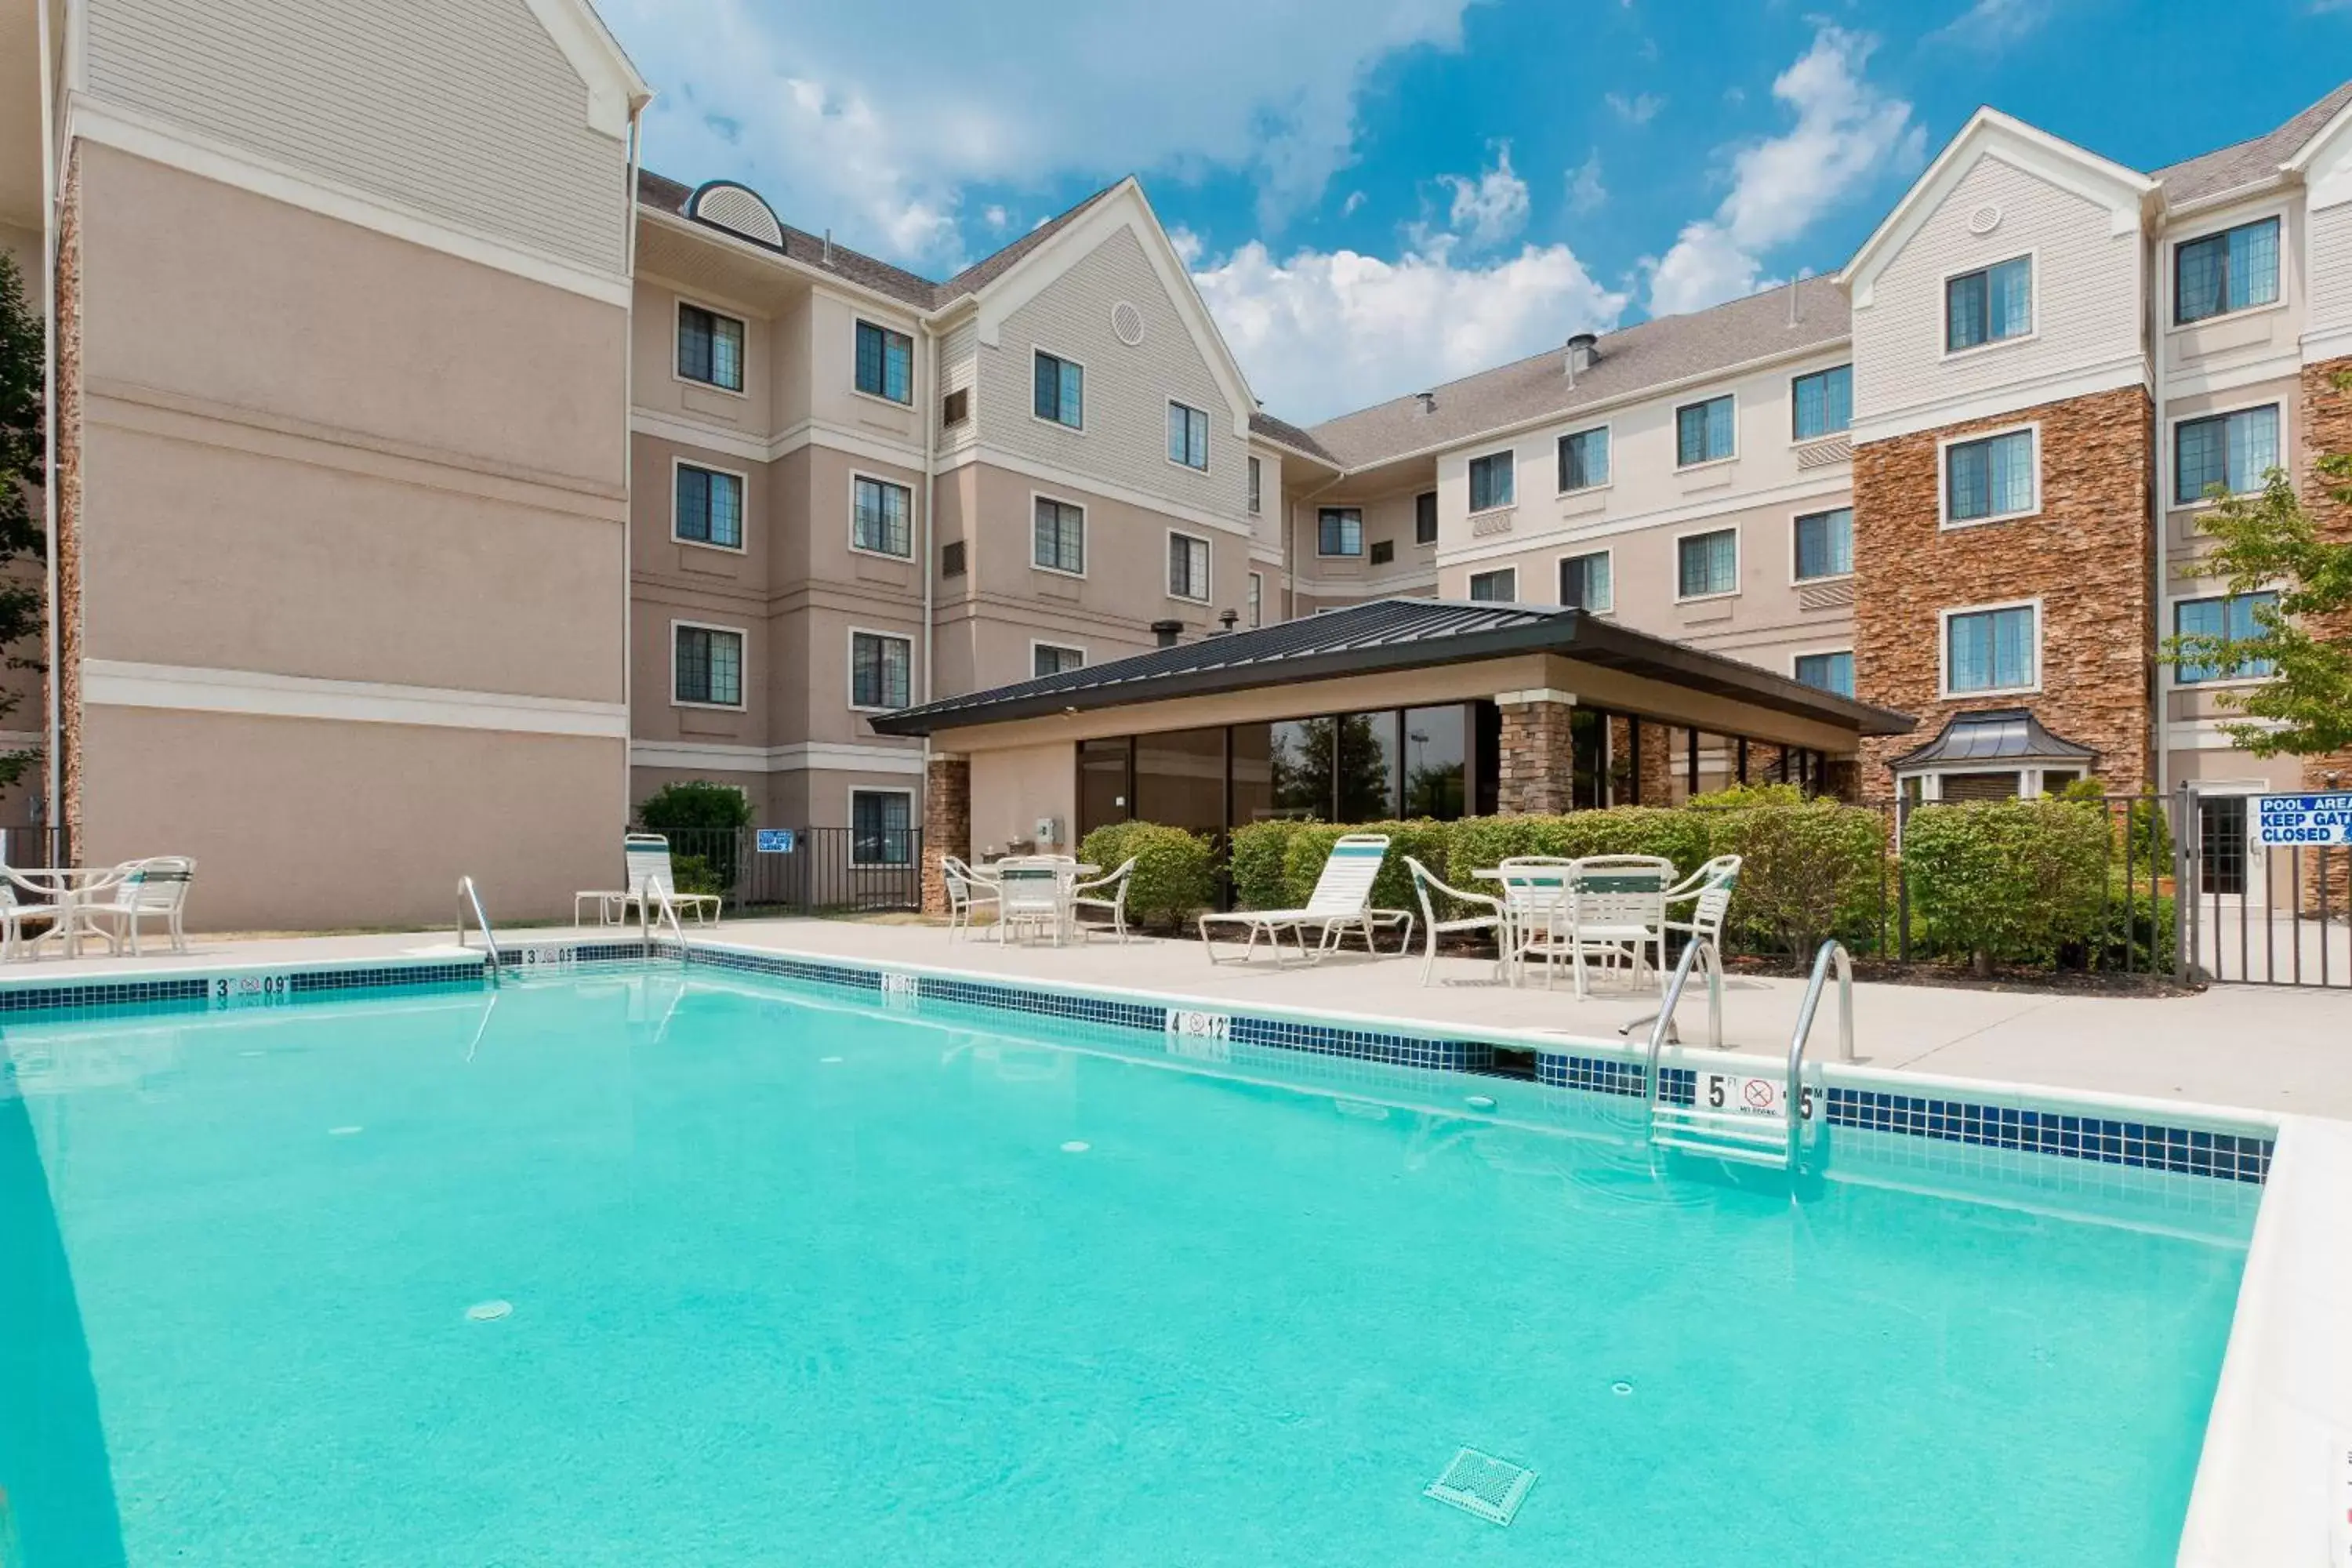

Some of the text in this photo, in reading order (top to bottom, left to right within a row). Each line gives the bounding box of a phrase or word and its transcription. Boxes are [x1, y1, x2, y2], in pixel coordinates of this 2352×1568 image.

[2263, 799, 2306, 811] POOL
[2260, 811, 2352, 827] KEEP GAT
[2262, 827, 2331, 842] CLOSED
[217, 978, 228, 996] 3
[1709, 1075, 1725, 1108] 5
